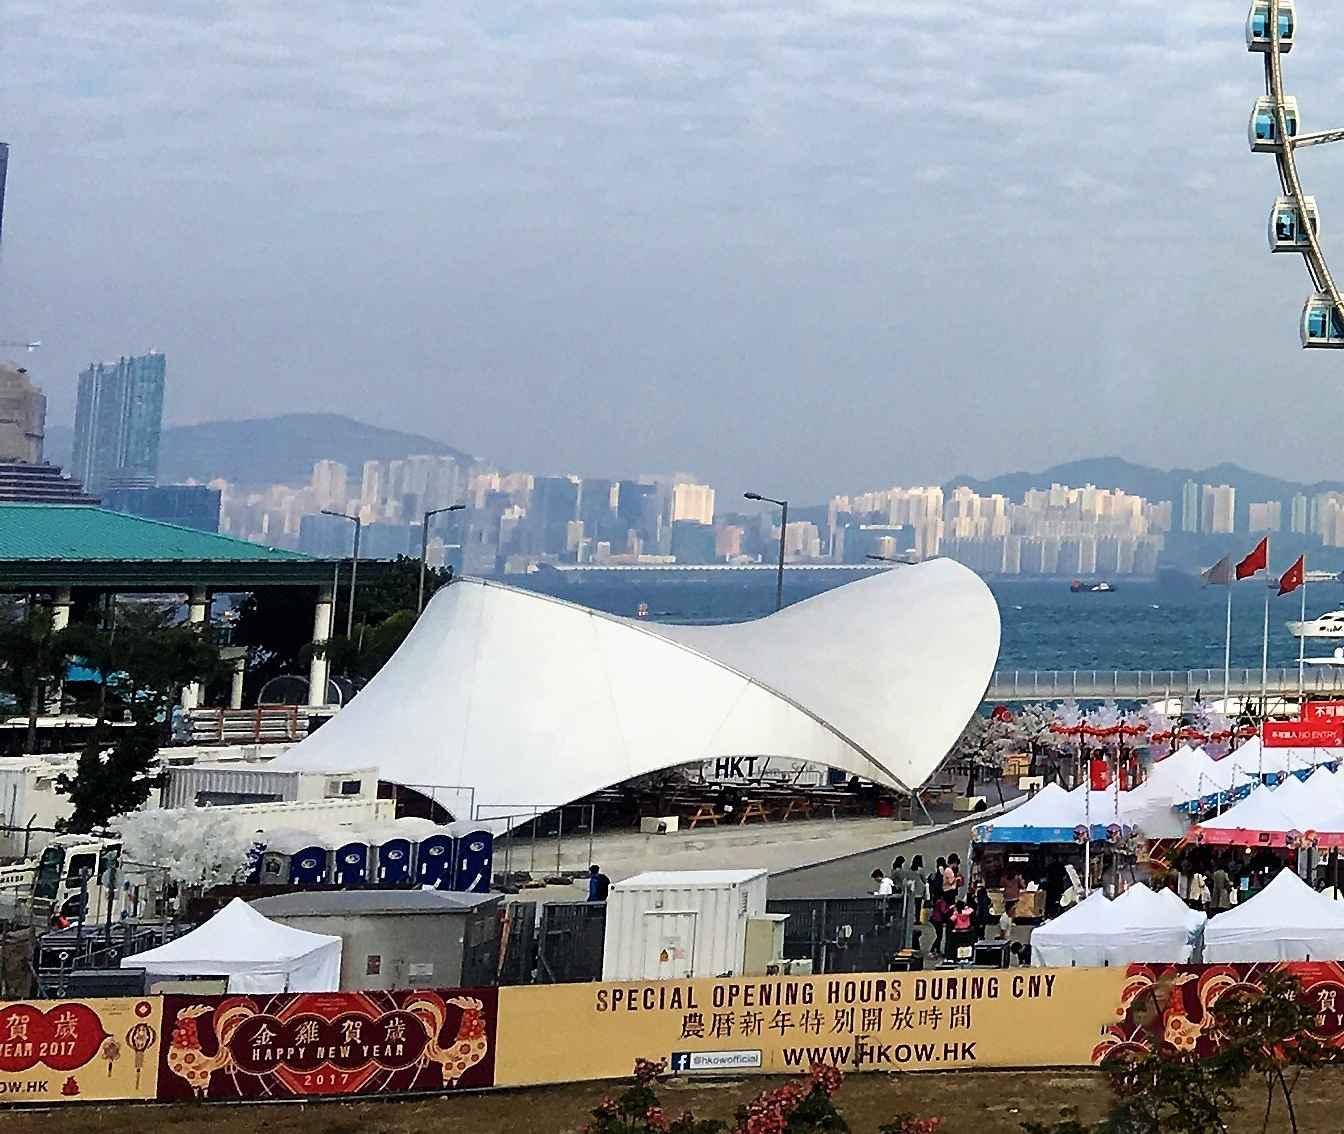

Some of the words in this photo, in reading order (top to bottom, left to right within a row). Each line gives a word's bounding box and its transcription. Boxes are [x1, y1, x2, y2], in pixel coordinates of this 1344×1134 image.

[1299, 730, 1310, 739] NO
[1311, 730, 1338, 739] ENTRY
[714, 756, 759, 778] HKT
[596, 986, 698, 1012] SPECIAL
[712, 982, 813, 1008] OPENING
[827, 978, 902, 1004] HOURS
[915, 976, 999, 1002] DURING
[1012, 974, 1056, 998] CNY
[250, 1017, 406, 1047] 金雞賀歲
[39, 1041, 76, 1057] 2017
[252, 1047, 306, 1061] HAPPY
[317, 1045, 350, 1059] NEW
[363, 1044, 404, 1058] YEAR
[783, 1042, 977, 1066] WWW.HKOW.HK
[304, 1074, 349, 1086] 2017
